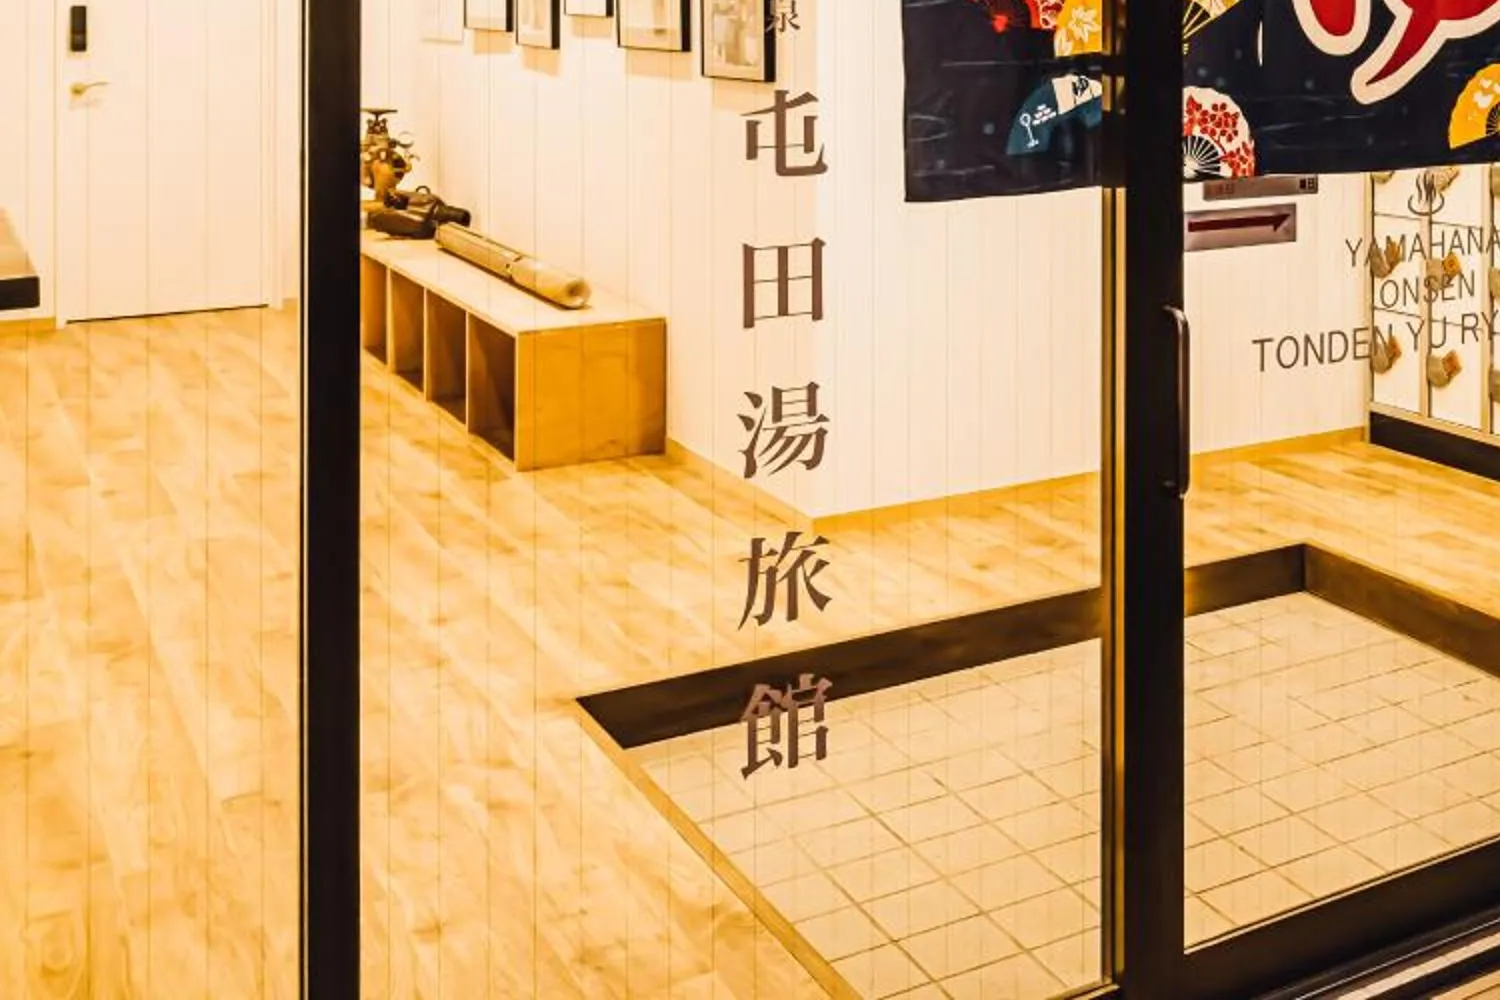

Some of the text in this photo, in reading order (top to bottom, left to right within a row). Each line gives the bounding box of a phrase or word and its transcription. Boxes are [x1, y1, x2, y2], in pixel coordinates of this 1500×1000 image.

[1379, 268, 1476, 309] ONSEN
[1251, 322, 1394, 373] TONDEN
[1405, 317, 1447, 353] YU
[736, 89, 834, 781] 屯田湯旅館
